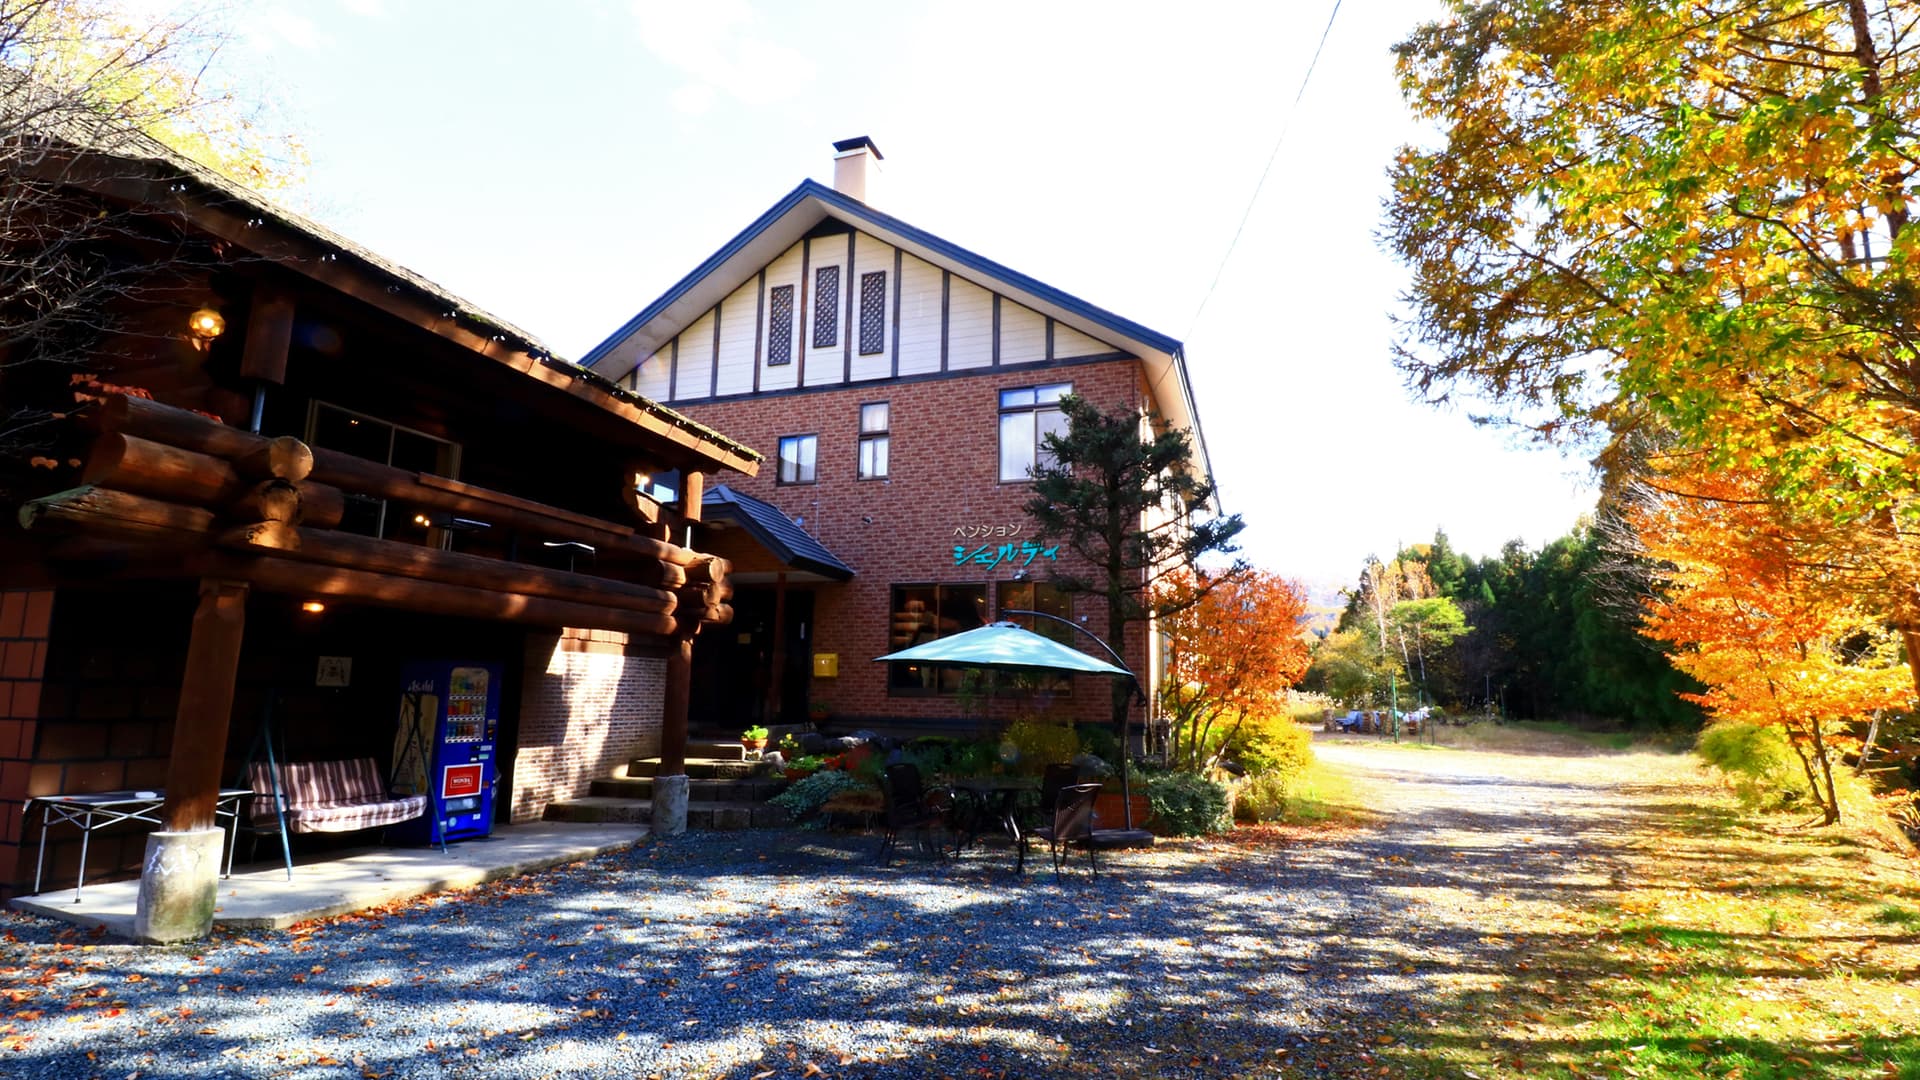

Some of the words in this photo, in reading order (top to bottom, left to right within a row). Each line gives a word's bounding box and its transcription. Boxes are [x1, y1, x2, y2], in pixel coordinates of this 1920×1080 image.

[953, 524, 1021, 538] ペンション
[953, 541, 1060, 571] シェルディ
